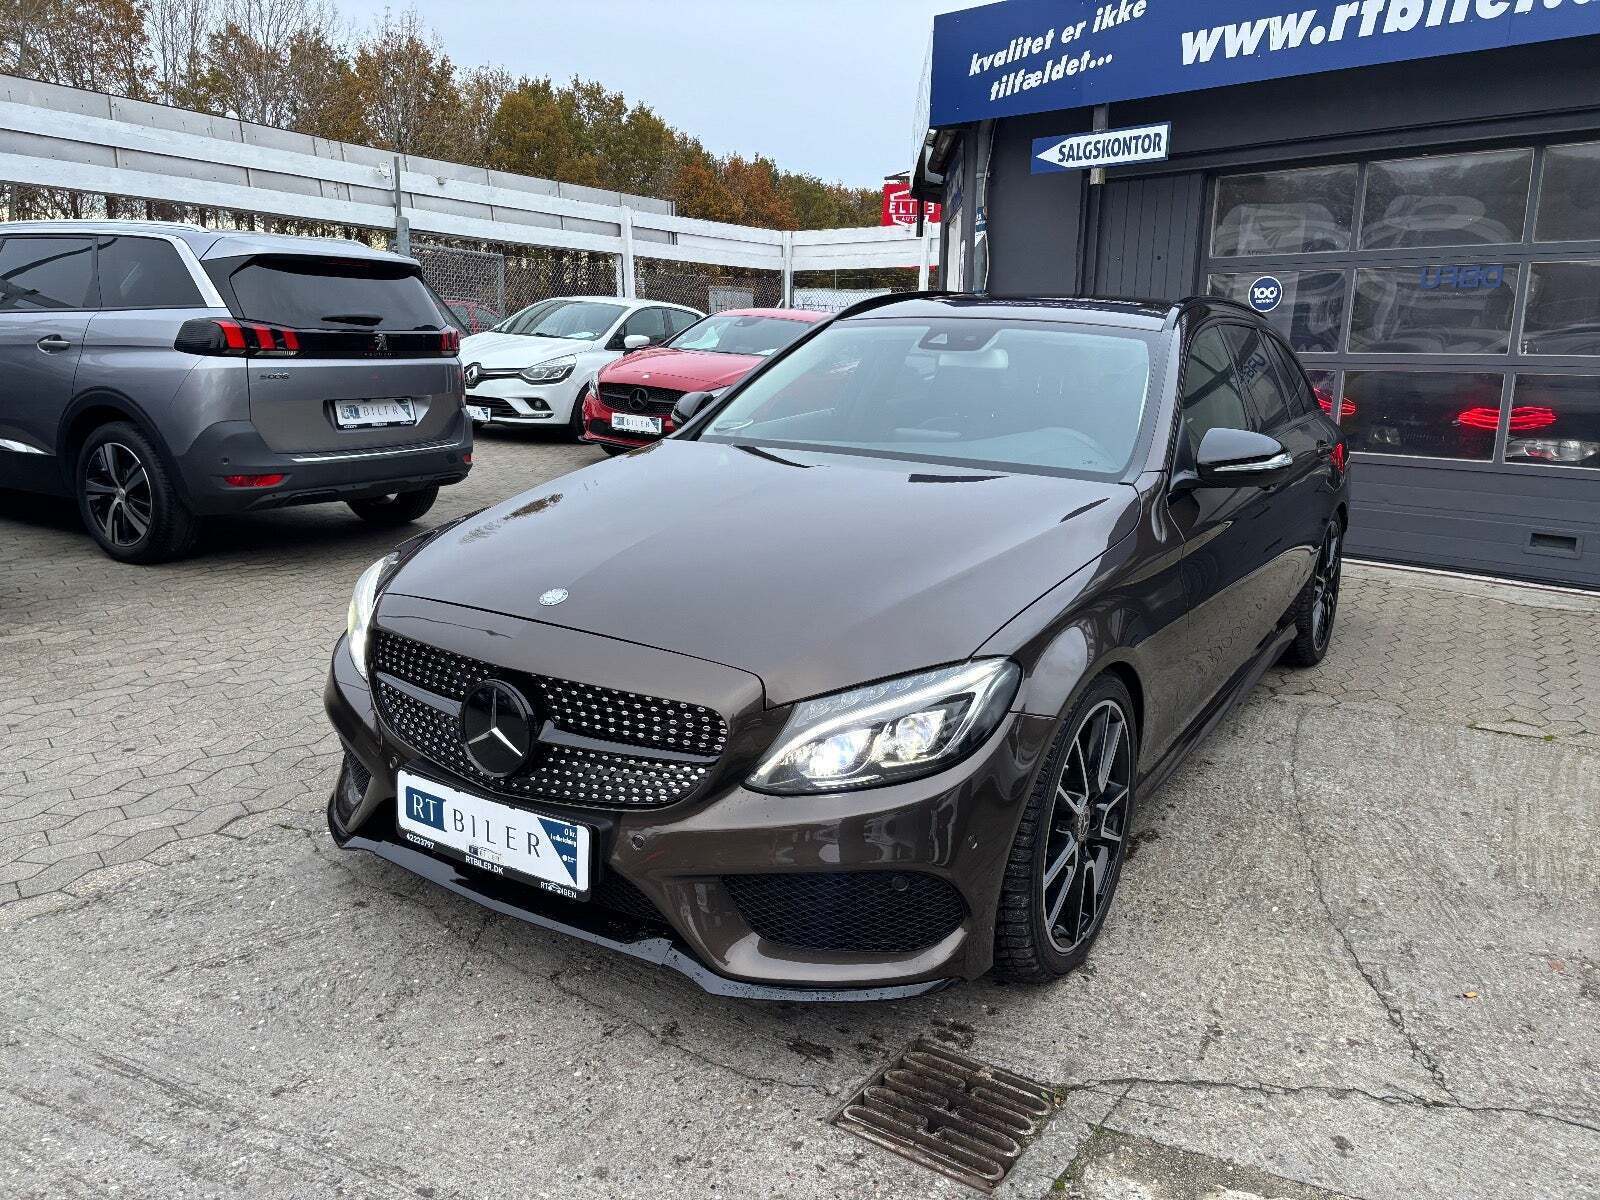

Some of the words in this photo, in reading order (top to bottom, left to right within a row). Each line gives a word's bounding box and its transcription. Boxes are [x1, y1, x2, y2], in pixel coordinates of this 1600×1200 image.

[969, 29, 1054, 76] kvalitet
[1061, 21, 1086, 43] er
[1092, 0, 1147, 33] ikke
[990, 50, 1113, 101] tilfældet...
[1058, 132, 1162, 163] SALGSKONTOR
[889, 201, 935, 214] ELIE
[412, 793, 437, 822] RT
[453, 808, 541, 858] BILER
[465, 855, 504, 876] RTBILER.DK
